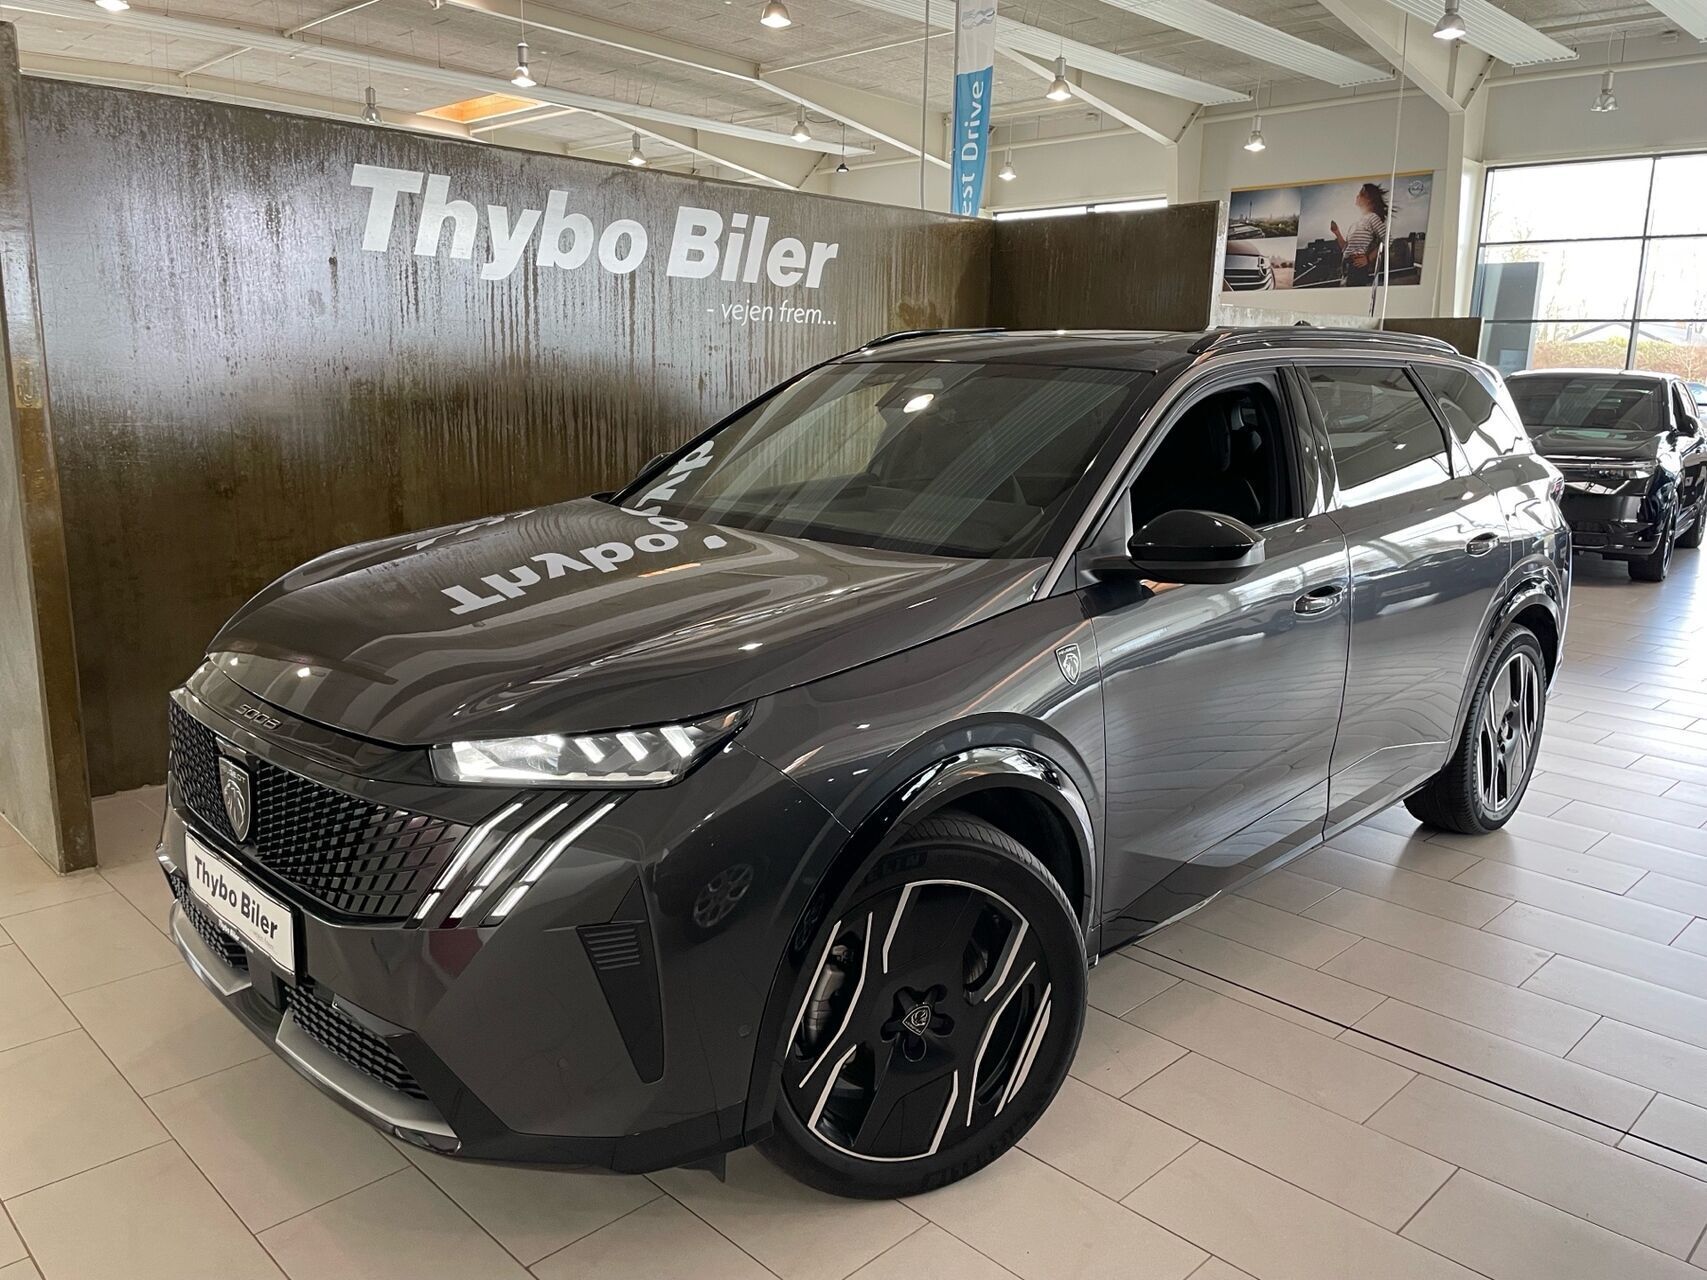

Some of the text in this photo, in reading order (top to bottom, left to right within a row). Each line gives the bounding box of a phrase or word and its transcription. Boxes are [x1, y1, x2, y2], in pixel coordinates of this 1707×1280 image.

[961, 81, 984, 216] est Drive
[351, 163, 839, 289] Thybo Biler
[721, 299, 773, 326] vejen
[779, 299, 837, 325] frem...
[235, 703, 281, 730] 5008
[194, 855, 237, 908] Thybo
[240, 891, 278, 939] Biler
